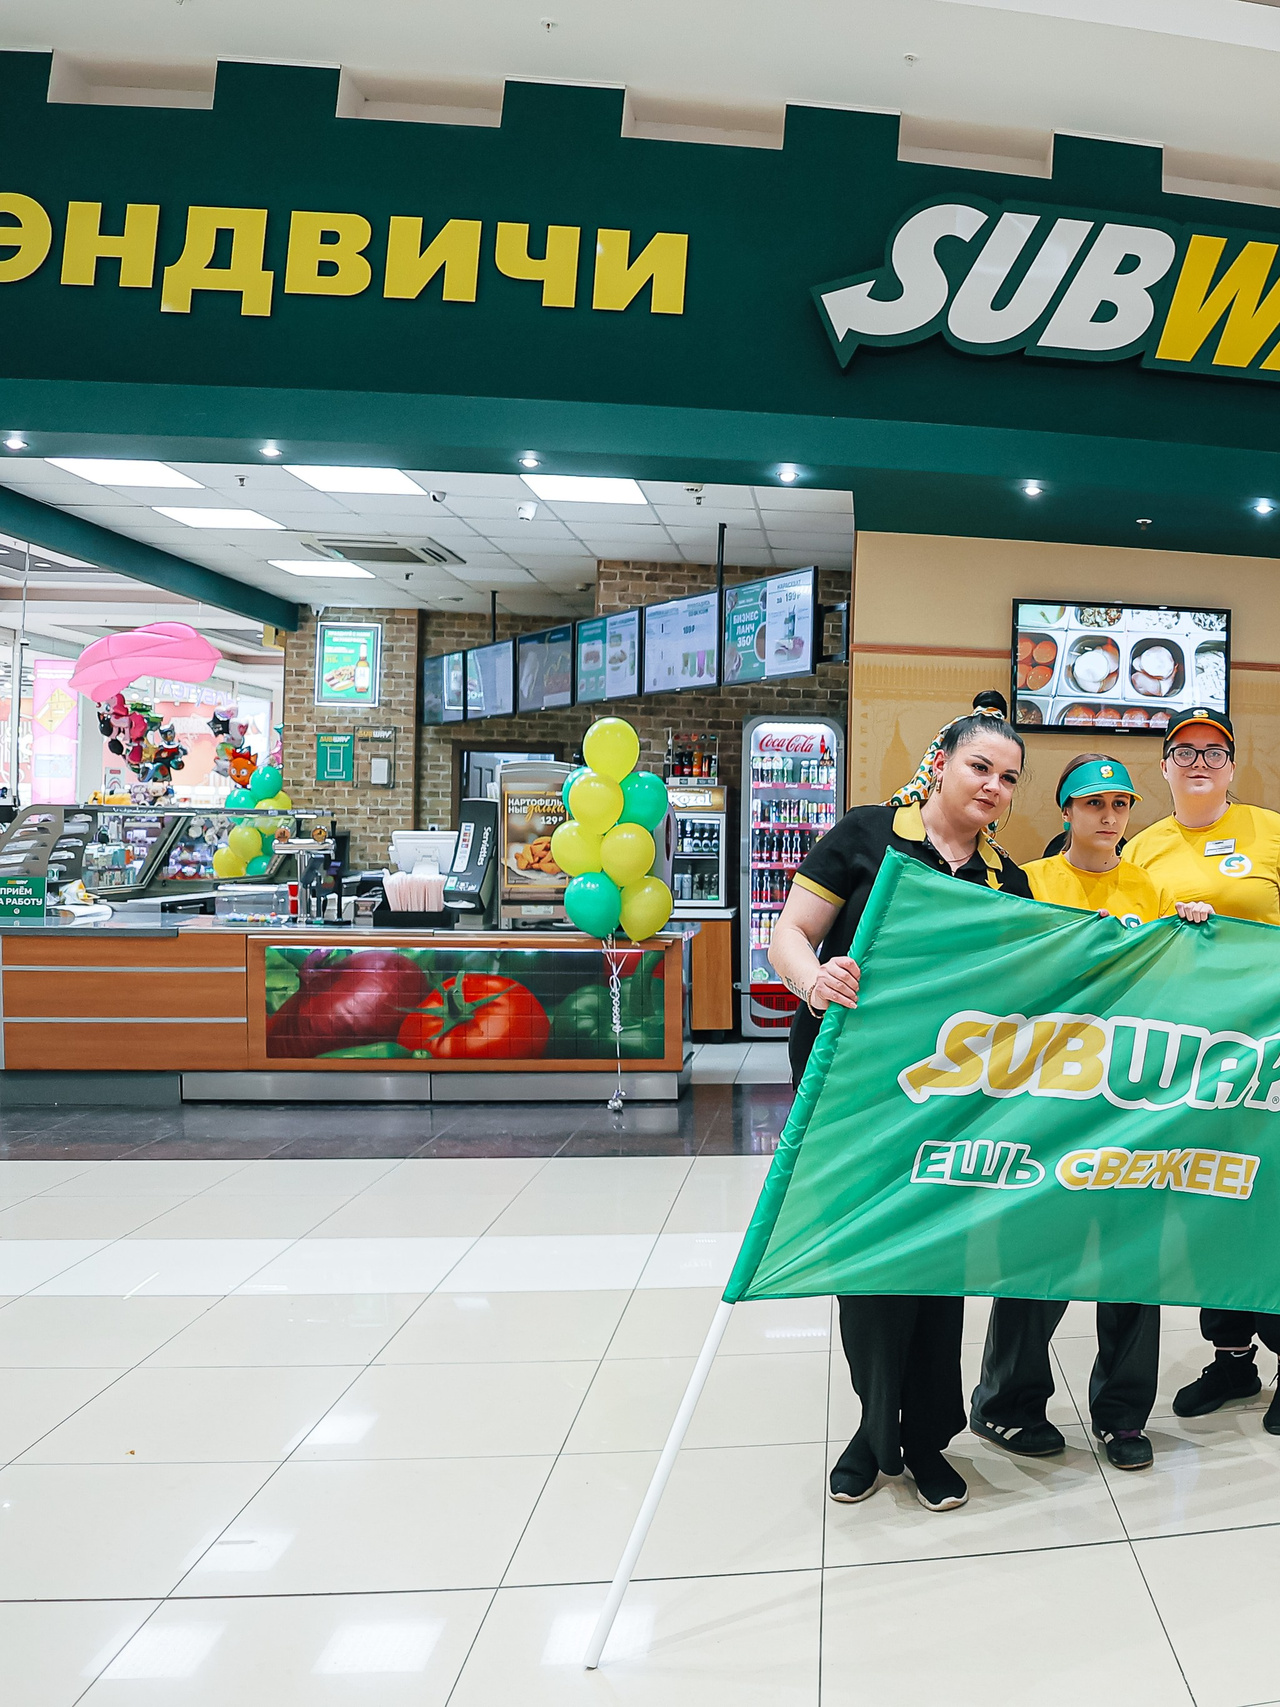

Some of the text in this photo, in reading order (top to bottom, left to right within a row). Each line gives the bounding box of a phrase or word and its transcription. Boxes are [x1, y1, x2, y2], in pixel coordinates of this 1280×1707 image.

[733, 610, 759, 625] БИЗНЕС
[736, 623, 755, 636] ЛАНЧ
[0, 886, 33, 896] ПРИЁМ
[5, 897, 43, 906] РАБОТУ
[910, 1139, 1261, 1200] ЕШЬ СВЕЖЕЕ!
